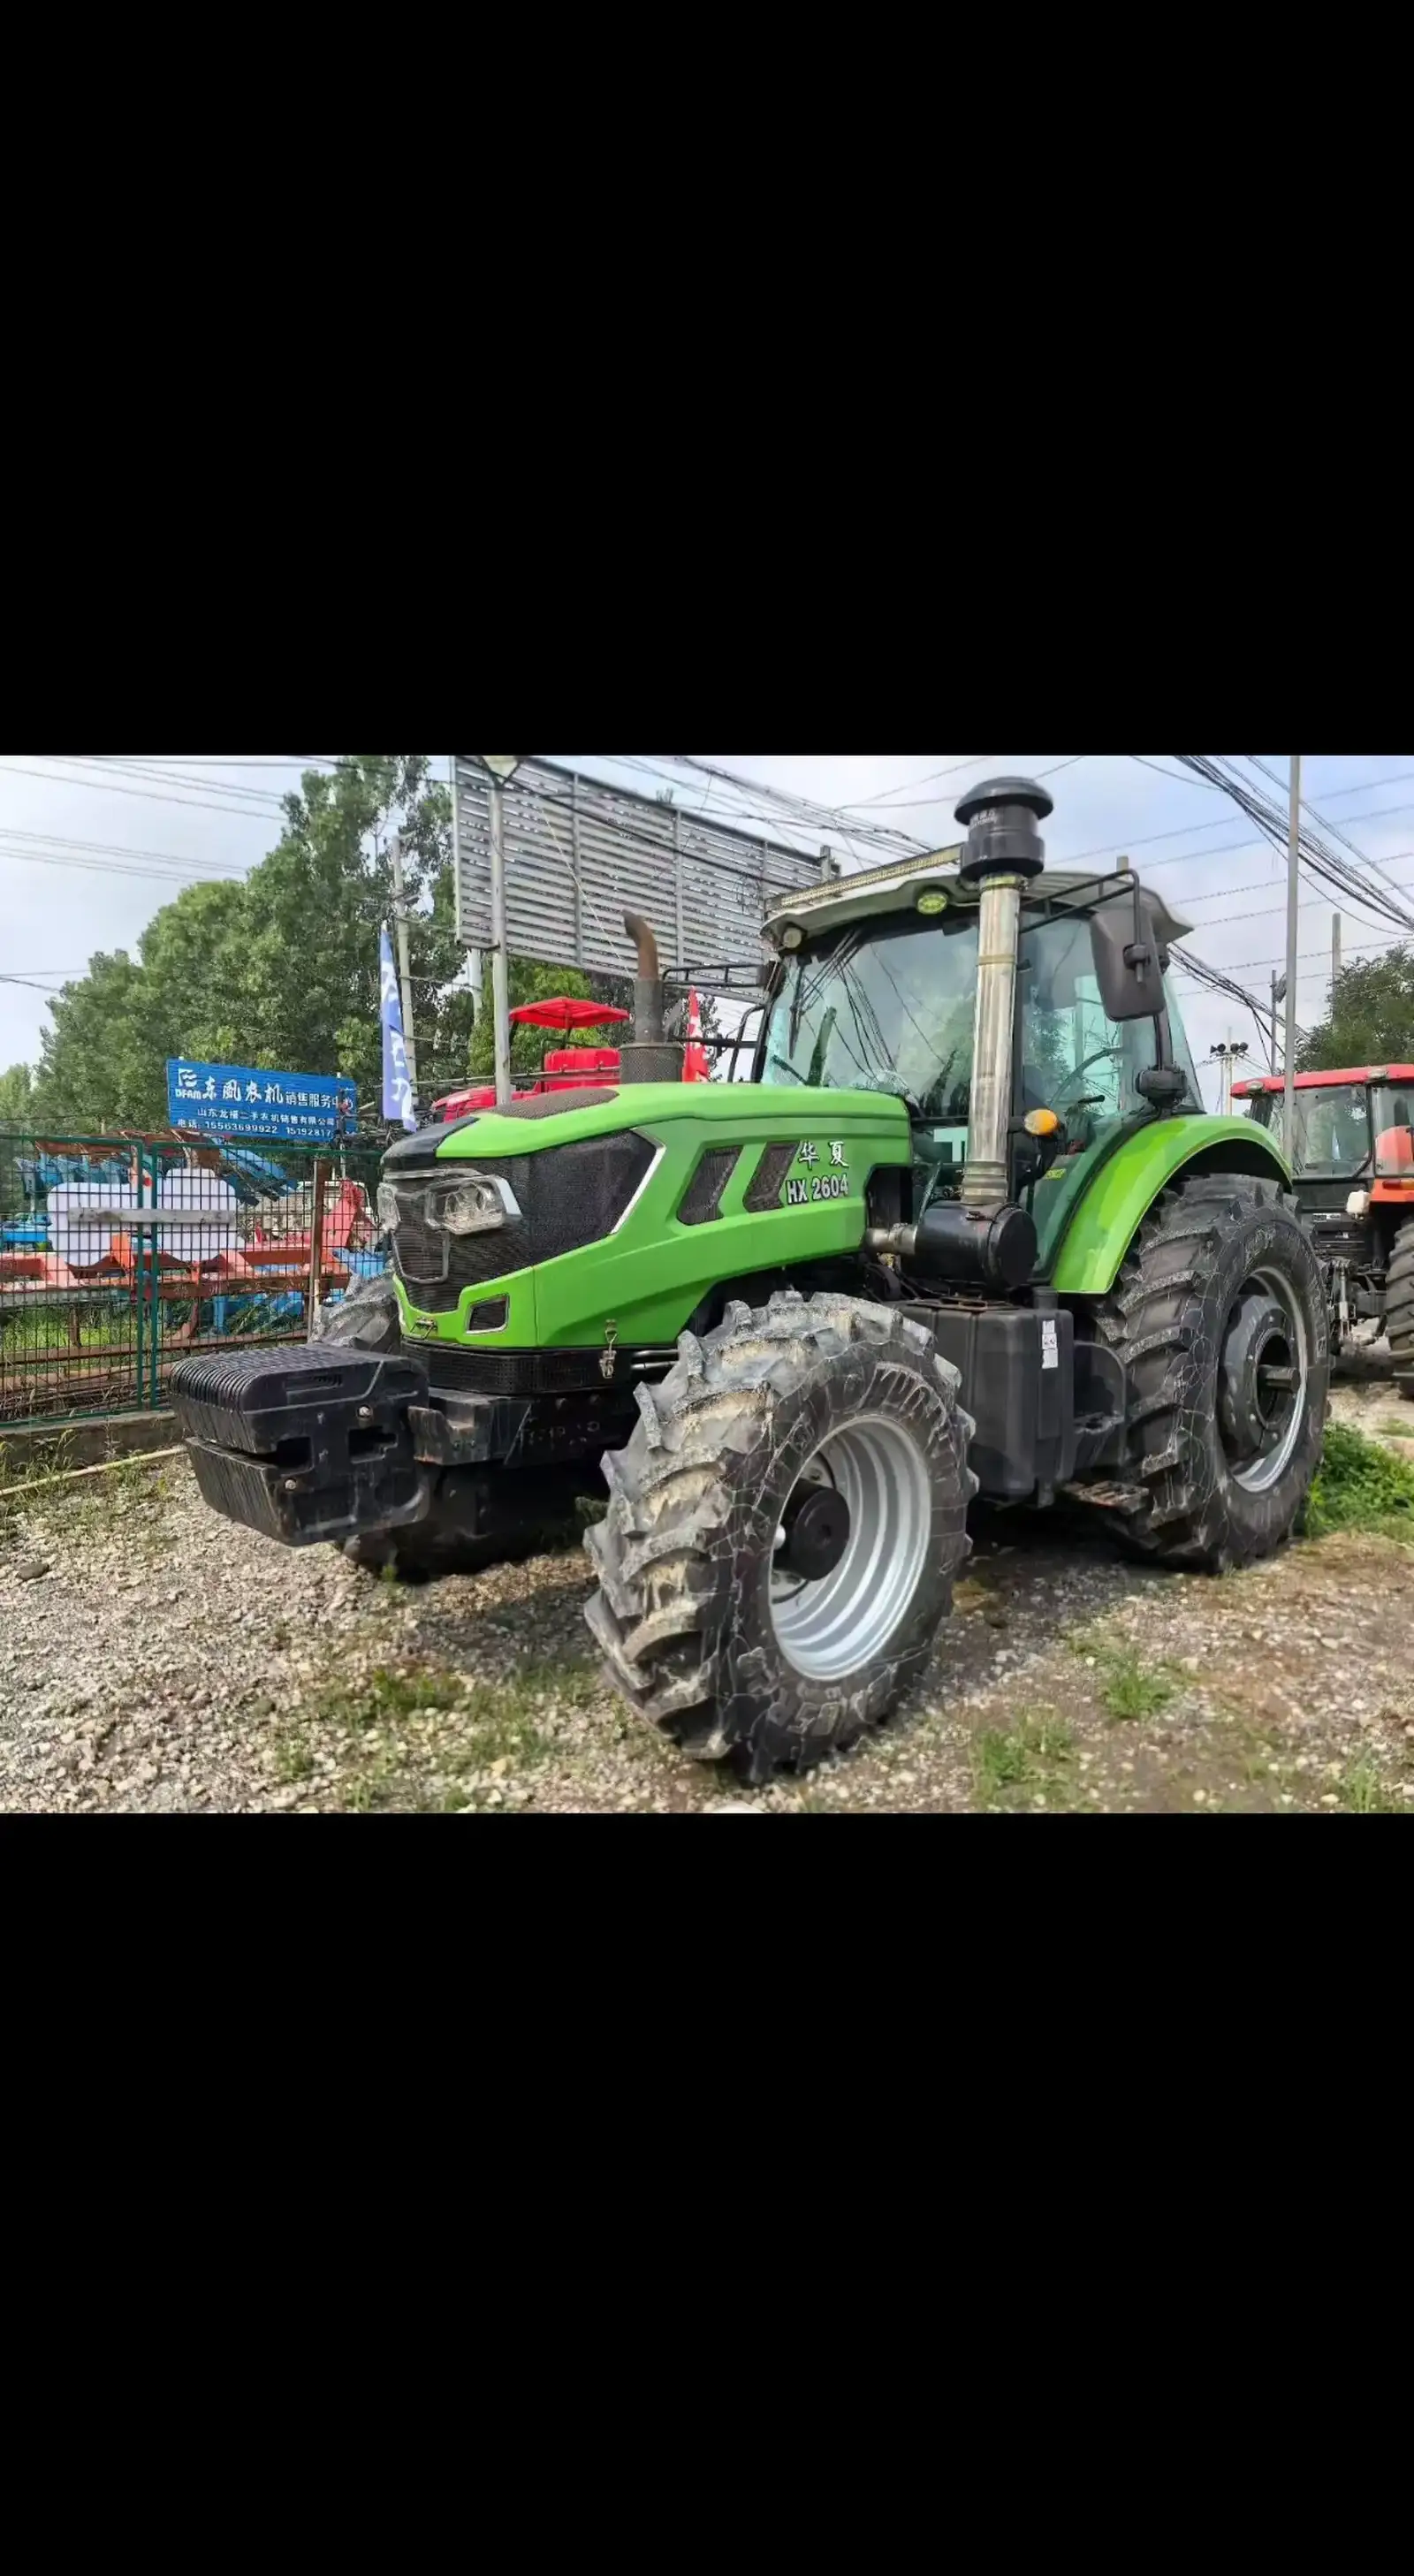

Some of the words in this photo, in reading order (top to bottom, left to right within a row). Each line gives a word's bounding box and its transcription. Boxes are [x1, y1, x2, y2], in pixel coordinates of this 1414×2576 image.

[285, 1127, 338, 1138] 15192817
[798, 1141, 849, 1170] 华夏
[786, 1178, 809, 1204] HX
[811, 1173, 849, 1201] 2604
